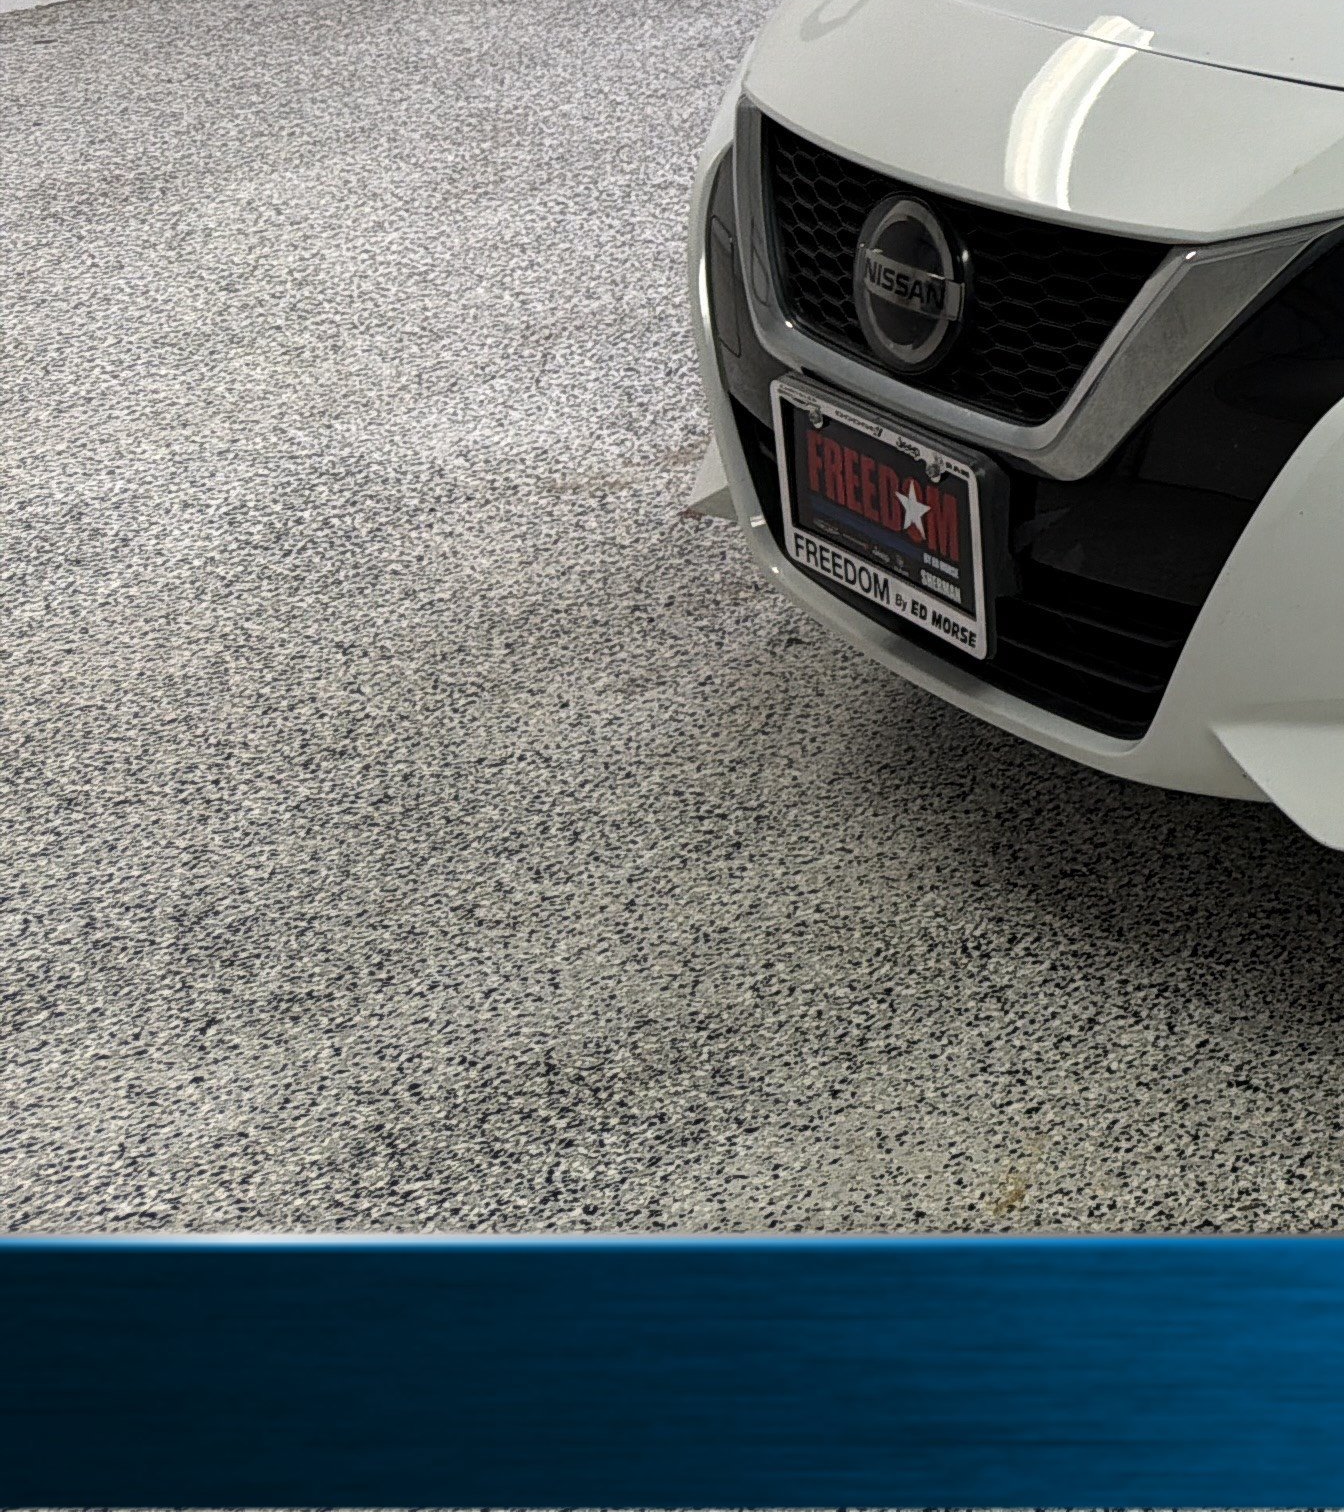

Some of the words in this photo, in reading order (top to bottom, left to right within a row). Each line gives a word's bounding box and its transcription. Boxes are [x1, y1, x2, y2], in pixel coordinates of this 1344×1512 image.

[864, 256, 946, 310] NISSAN
[805, 429, 960, 563] FREEDOM
[793, 531, 891, 606] FREEDOM
[910, 599, 928, 623] ED
[931, 609, 977, 650] MORSE
